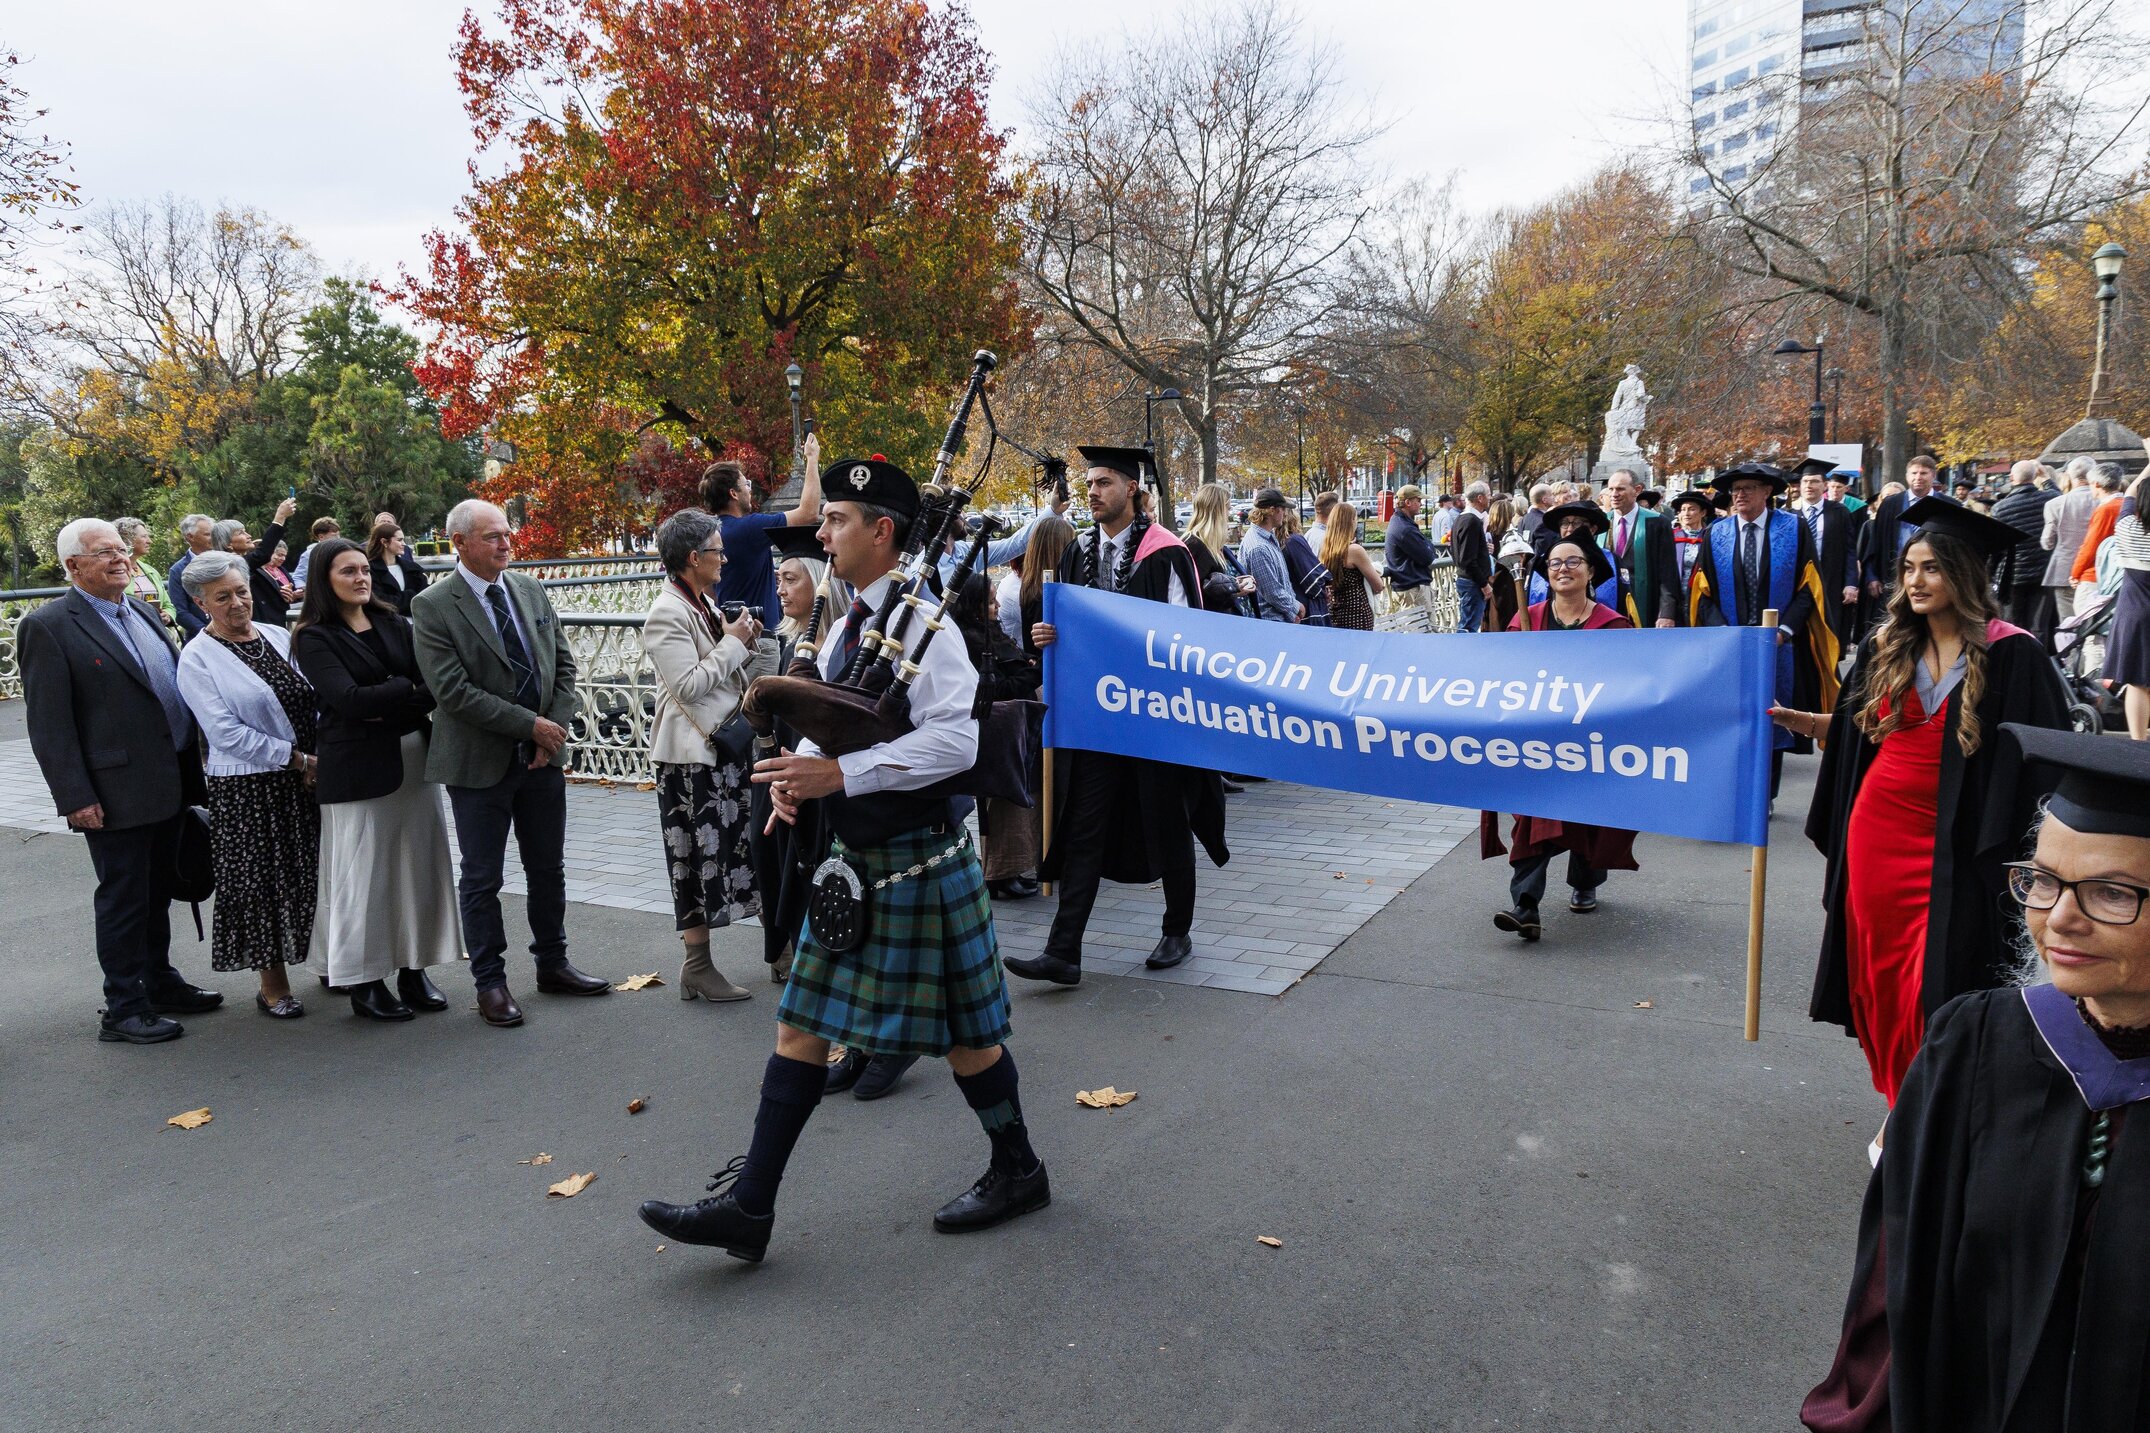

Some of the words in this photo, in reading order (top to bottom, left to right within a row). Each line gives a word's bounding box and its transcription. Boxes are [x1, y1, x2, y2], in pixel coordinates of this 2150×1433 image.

[1145, 629, 1313, 691] Lincoln
[1328, 660, 1605, 725] University
[1096, 675, 1343, 750] Graduation
[1354, 714, 1689, 783] Procession
